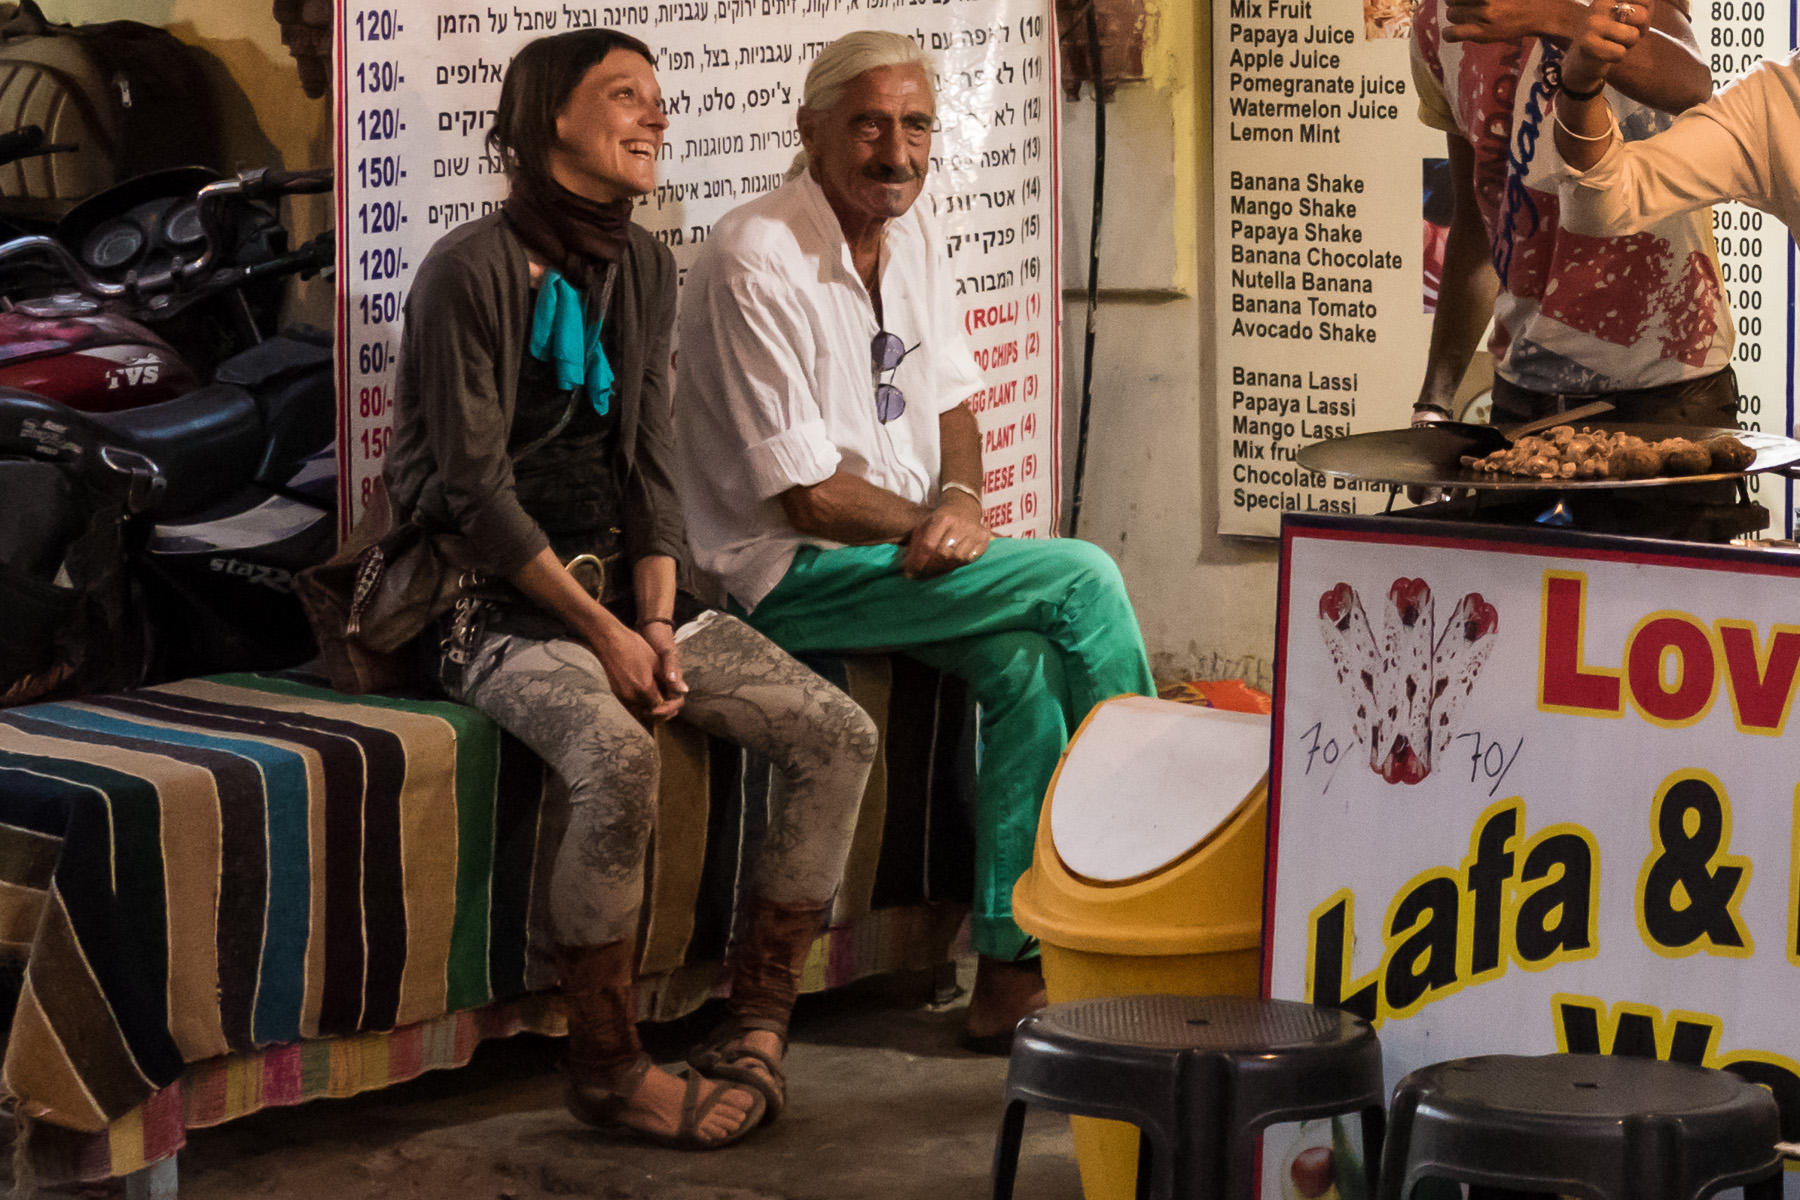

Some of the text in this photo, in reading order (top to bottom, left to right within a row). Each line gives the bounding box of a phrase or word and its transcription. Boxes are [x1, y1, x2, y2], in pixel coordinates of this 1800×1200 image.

[1230, 0, 1312, 19] Mix Fruit
[1711, 1, 1765, 22] 80.00
[356, 9, 404, 41] 120/-
[1230, 24, 1355, 47] Papaya Juice
[1711, 27, 1764, 47] 80.00
[1230, 48, 1340, 72] Apple Juice
[357, 61, 405, 93] 130/-
[1230, 73, 1406, 98] Pomegranate juice
[1230, 98, 1398, 119] Watermelon Juice
[357, 108, 406, 141] 120/-
[1230, 122, 1340, 143] Lemon Mint
[358, 156, 407, 189] 150/-
[1230, 171, 1364, 194] Banana Shake
[358, 202, 408, 234] 120/-
[1230, 196, 1357, 220] Mango Shake
[1230, 221, 1363, 246] Papaya Shake
[359, 248, 408, 281] 120/-
[1231, 245, 1402, 270] Banana Chocolate
[1231, 270, 1372, 293] Nutella Banana
[964, 291, 1041, 336] (ROLL) (1)
[1231, 294, 1377, 318] Banana Tomato
[1231, 318, 1377, 343] Avocado Shake
[359, 343, 395, 374] 60/-
[991, 340, 1019, 369] CHIPS
[1025, 331, 1040, 361] (2)
[106, 364, 160, 390] TVS
[1232, 367, 1358, 392] Banana Lassi
[360, 387, 393, 418] 80/-
[987, 380, 1017, 411] PLANT
[1023, 373, 1038, 403] (3)
[1232, 391, 1355, 416] Papaya Lassi
[985, 412, 1037, 453] PLANT (4)
[1232, 415, 1350, 440] Mango Lassi
[1232, 440, 1264, 459] Mix
[1232, 464, 1327, 489] Chocolate
[1233, 488, 1356, 514] Special Lassi
[1308, 798, 1600, 1029] Lafa
[1632, 769, 1753, 957] &
